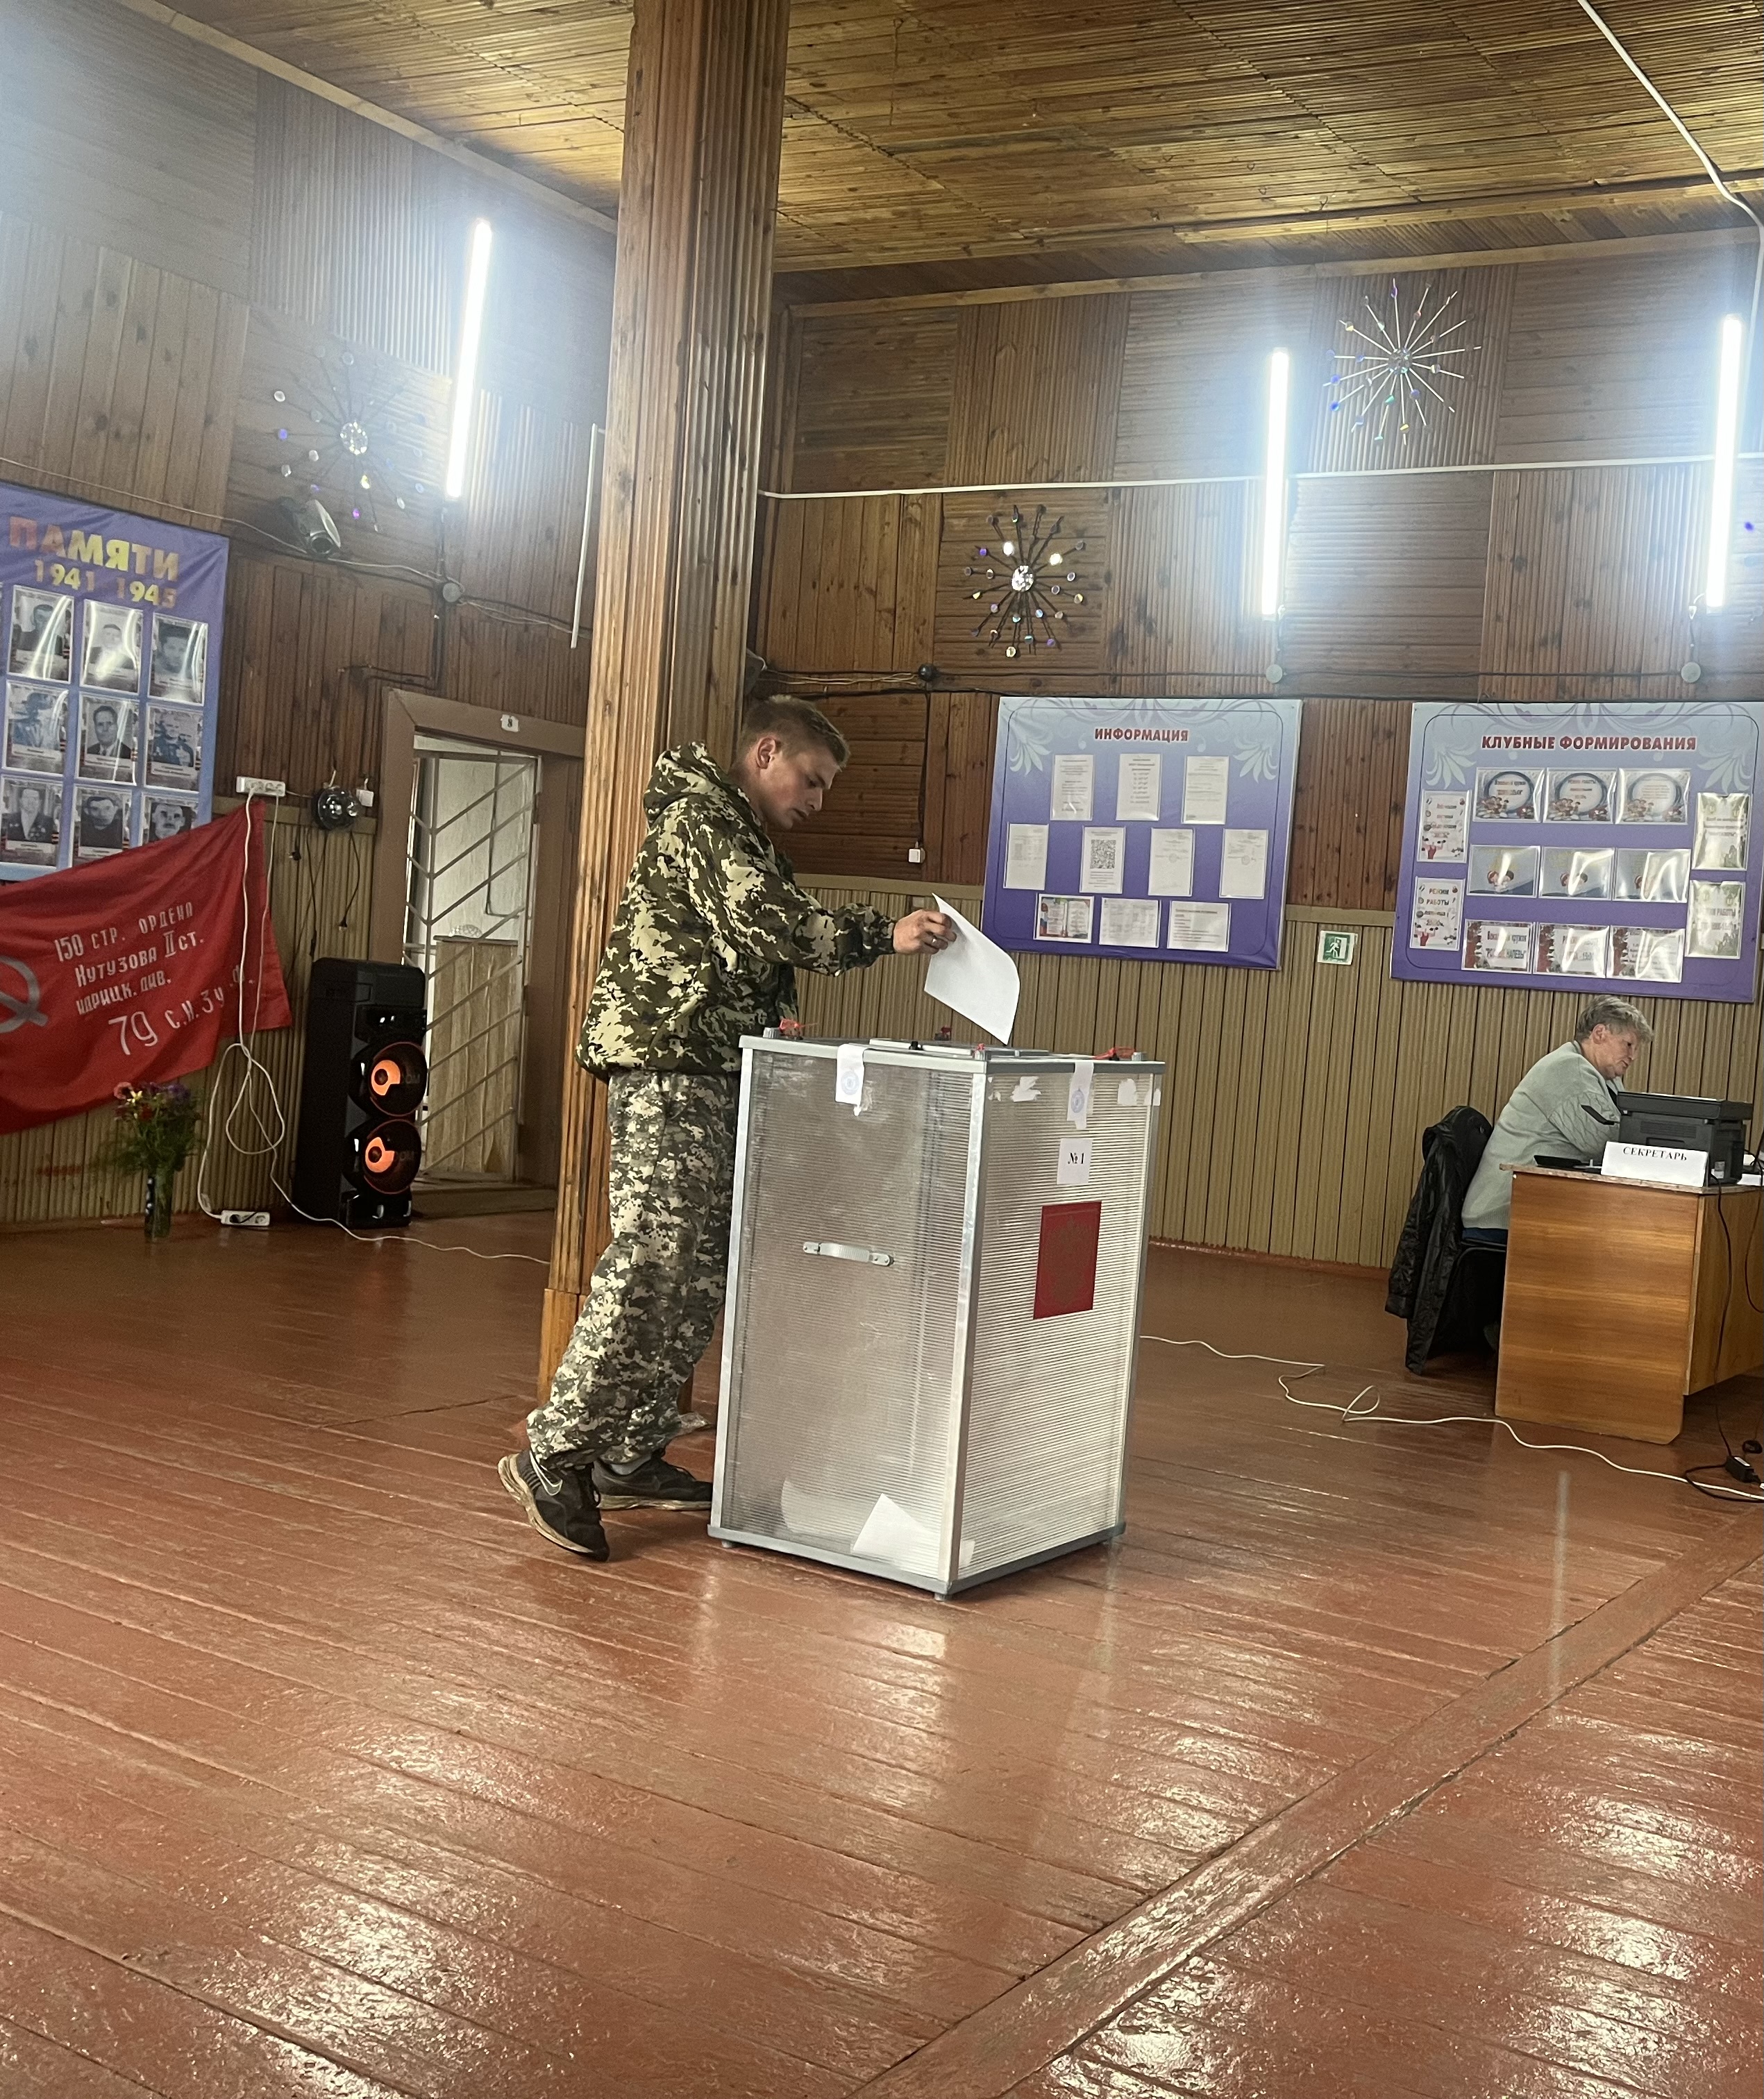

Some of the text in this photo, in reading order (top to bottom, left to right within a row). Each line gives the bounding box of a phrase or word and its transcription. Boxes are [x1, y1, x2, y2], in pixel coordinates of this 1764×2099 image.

[9, 516, 179, 582] ПАМЯТИ
[35, 558, 178, 609] 1941 1945
[507, 718, 513, 727] 8
[1094, 727, 1189, 743] ИНФОРМАЦИЯ
[1481, 736, 1697, 751] КЛУБНЫЕ ФОРМИРОВАНИЯ
[54, 902, 194, 963] 150 СТР. ОРДЕНА
[108, 1011, 158, 1056] 79
[1622, 1146, 1688, 1161] СЕКРЕТАРЬ
